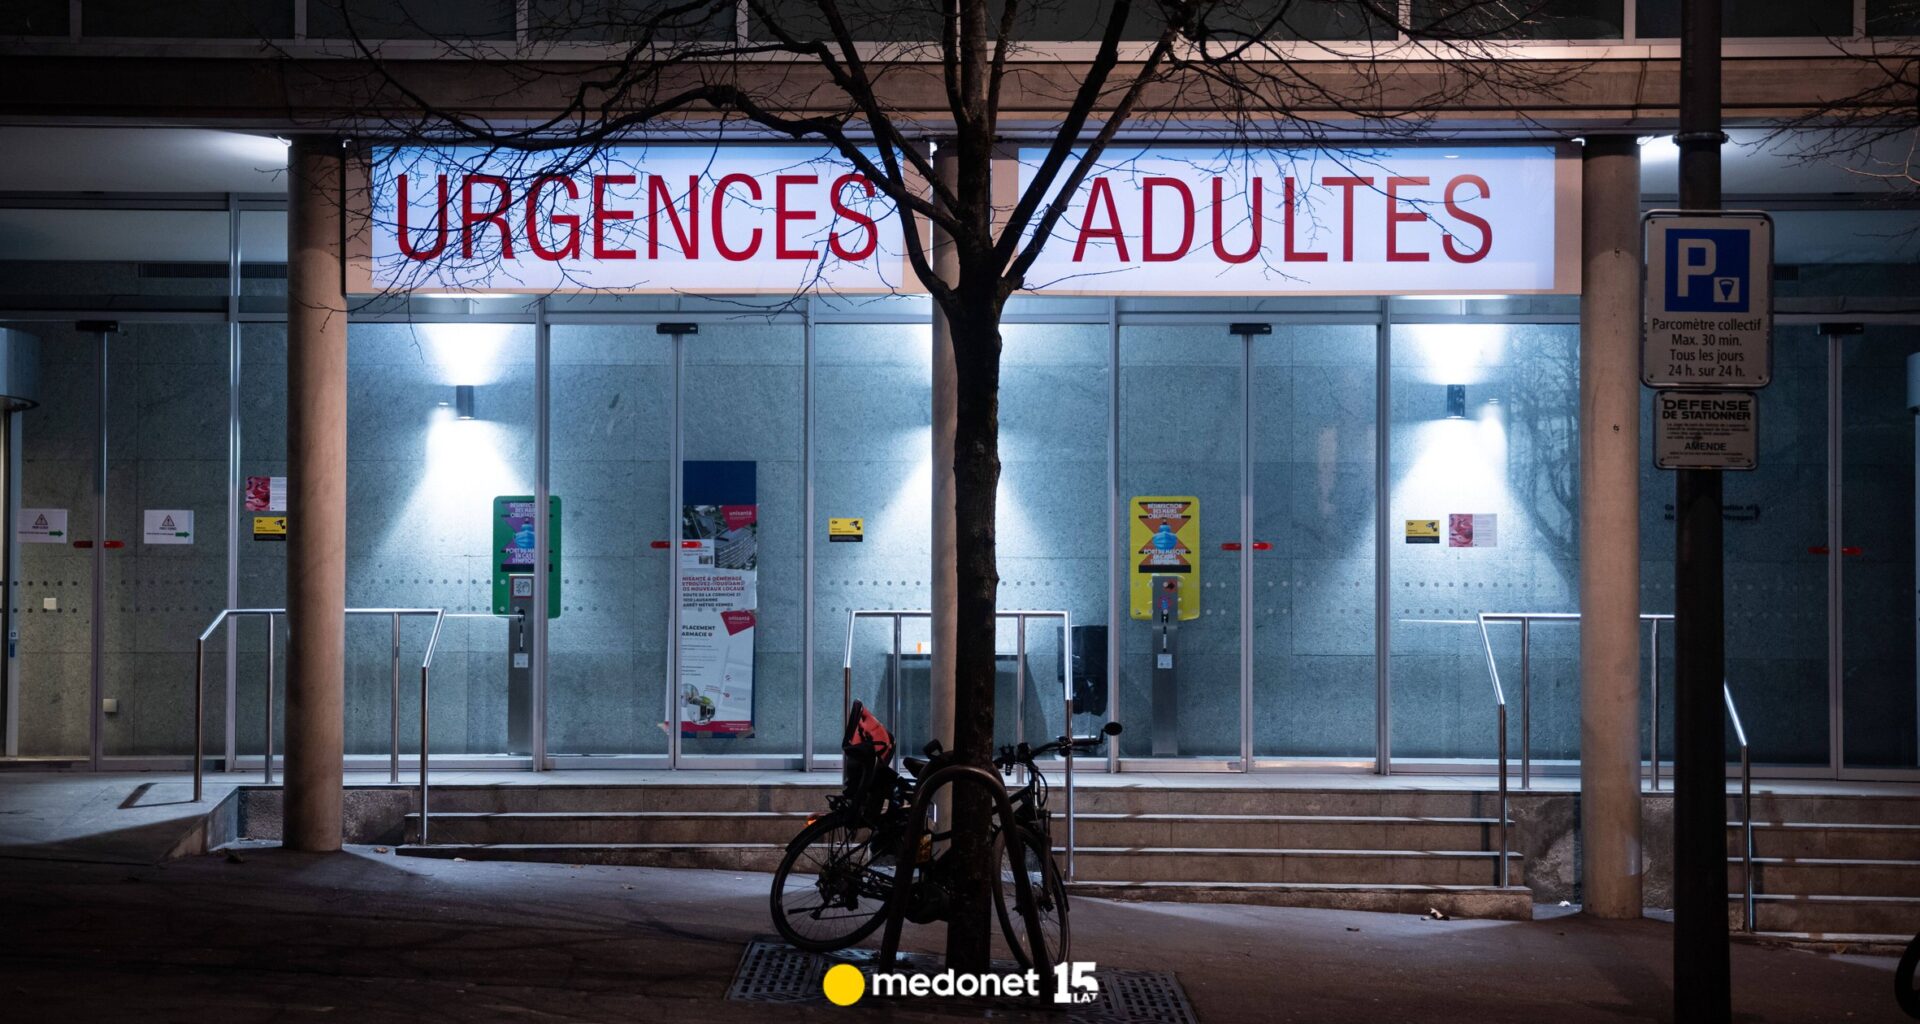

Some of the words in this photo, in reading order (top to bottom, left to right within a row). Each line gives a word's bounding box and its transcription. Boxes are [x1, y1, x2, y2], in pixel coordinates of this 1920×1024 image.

[398, 173, 878, 261] URGENCES
[1072, 174, 1493, 263] ADULTES
[1677, 238, 1716, 297] P
[1652, 318, 1715, 331] Parcomètre
[1718, 318, 1762, 331] collectif
[1671, 334, 1698, 346] Max.
[1701, 334, 1716, 346] 30
[1719, 334, 1742, 346] min.
[1669, 349, 1696, 361] Tous
[1698, 349, 1714, 361] les
[1716, 349, 1744, 364] jours
[1668, 364, 1682, 376] 24
[1685, 364, 1695, 376] h.
[1698, 367, 1716, 377] sur
[1718, 364, 1732, 377] 24
[1735, 365, 1745, 377] h.
[1663, 411, 1677, 419] DE
[1681, 411, 1751, 420] STATIONNER
[1684, 442, 1727, 451] AMENDE
